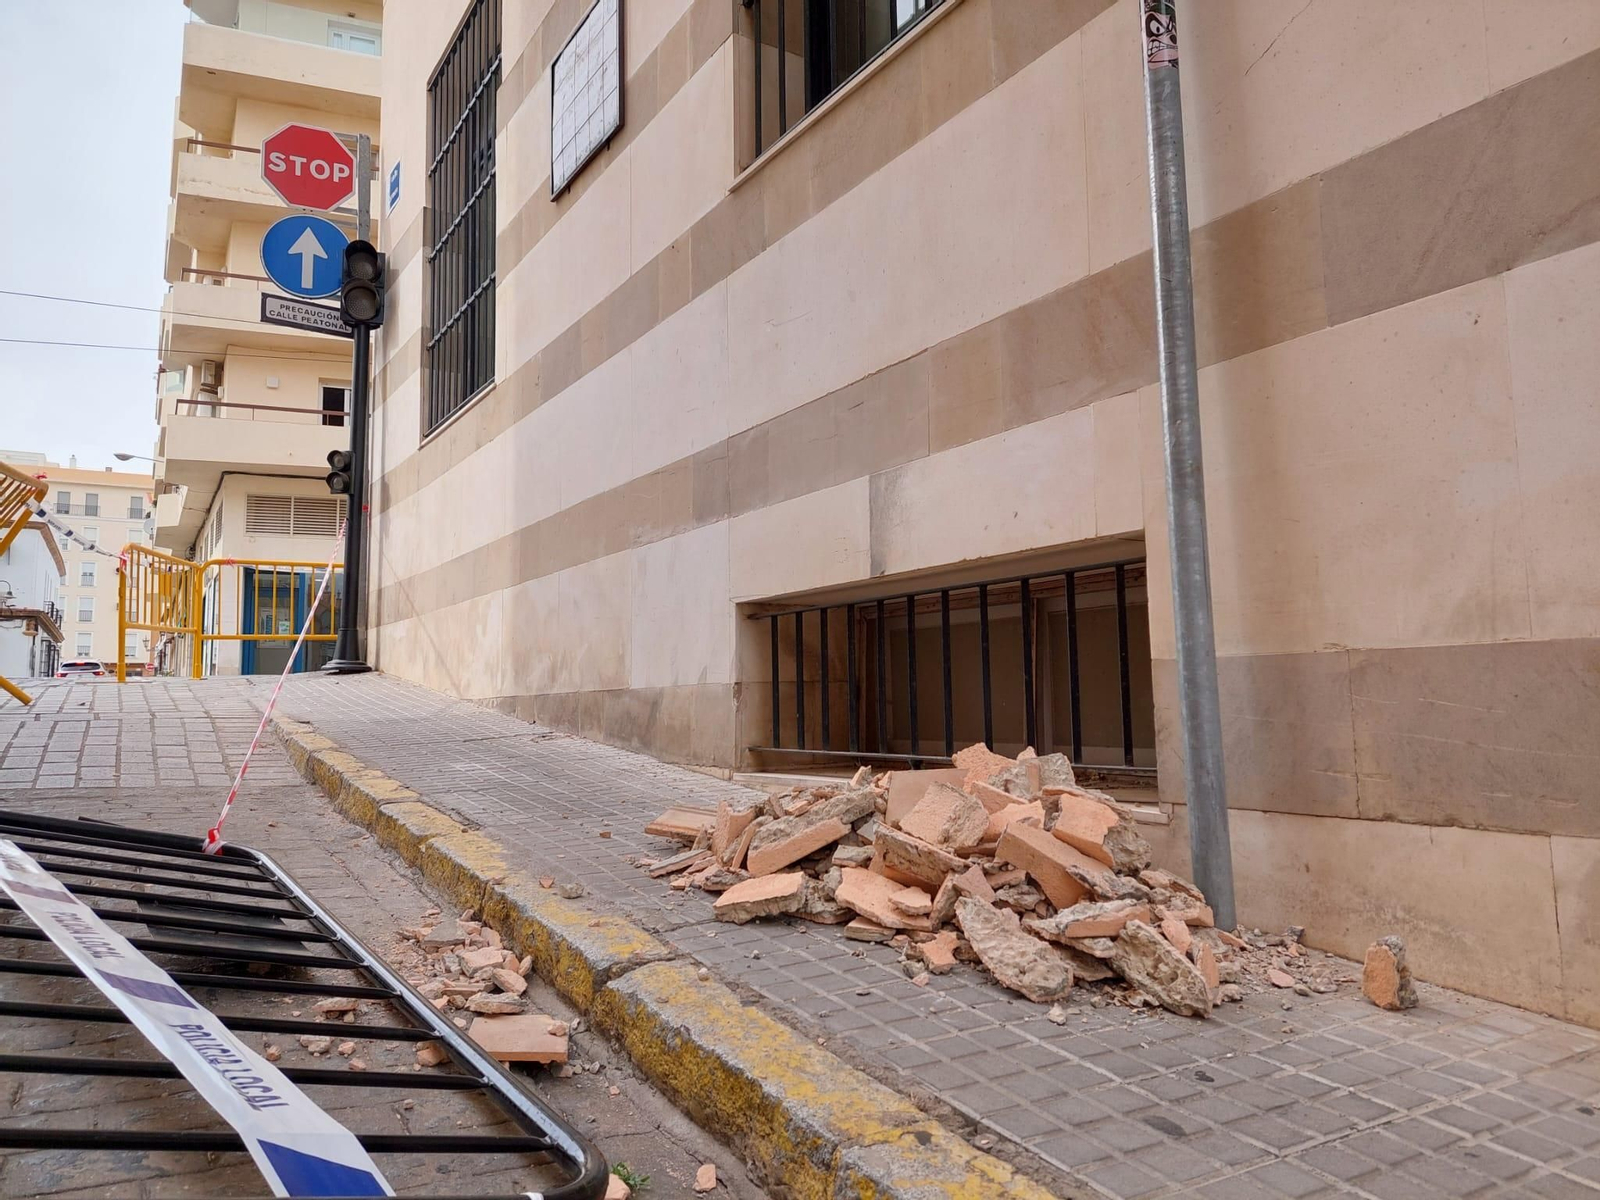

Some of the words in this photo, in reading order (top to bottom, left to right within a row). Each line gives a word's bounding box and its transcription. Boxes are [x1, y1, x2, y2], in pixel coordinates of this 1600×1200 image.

[268, 151, 350, 183] STOP
[269, 309, 298, 321] CALLE
[301, 316, 349, 332] PEATONAL
[280, 303, 340, 322] PRECAUCIÓN
[222, 1068, 290, 1112] LOCAL
